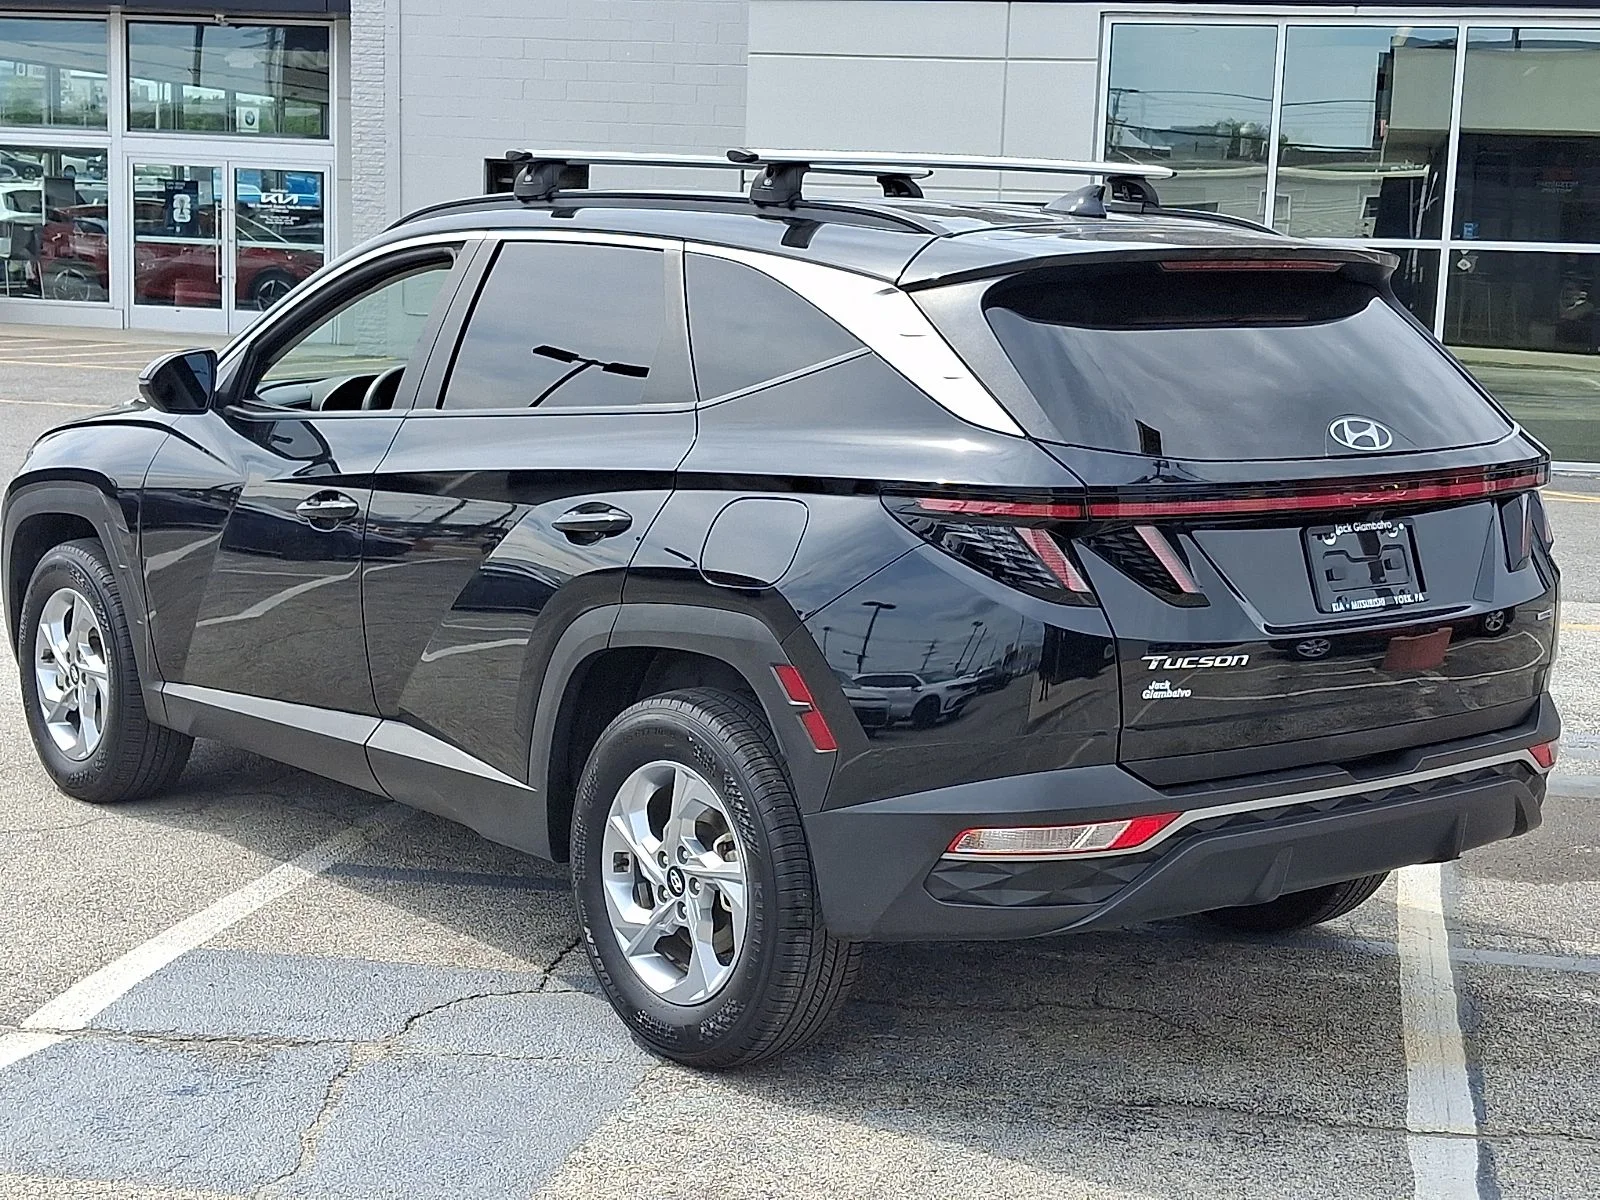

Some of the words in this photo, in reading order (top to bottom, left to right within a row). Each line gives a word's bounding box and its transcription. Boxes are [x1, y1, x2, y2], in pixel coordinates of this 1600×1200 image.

[260, 192, 298, 205] KIA
[1353, 520, 1393, 531] Giambalvo
[1332, 602, 1345, 612] KIA
[1351, 597, 1386, 610] MITSUBISHI
[1414, 592, 1424, 602] PA
[1149, 680, 1171, 690] Jack
[1142, 688, 1192, 699] Giambalvo
